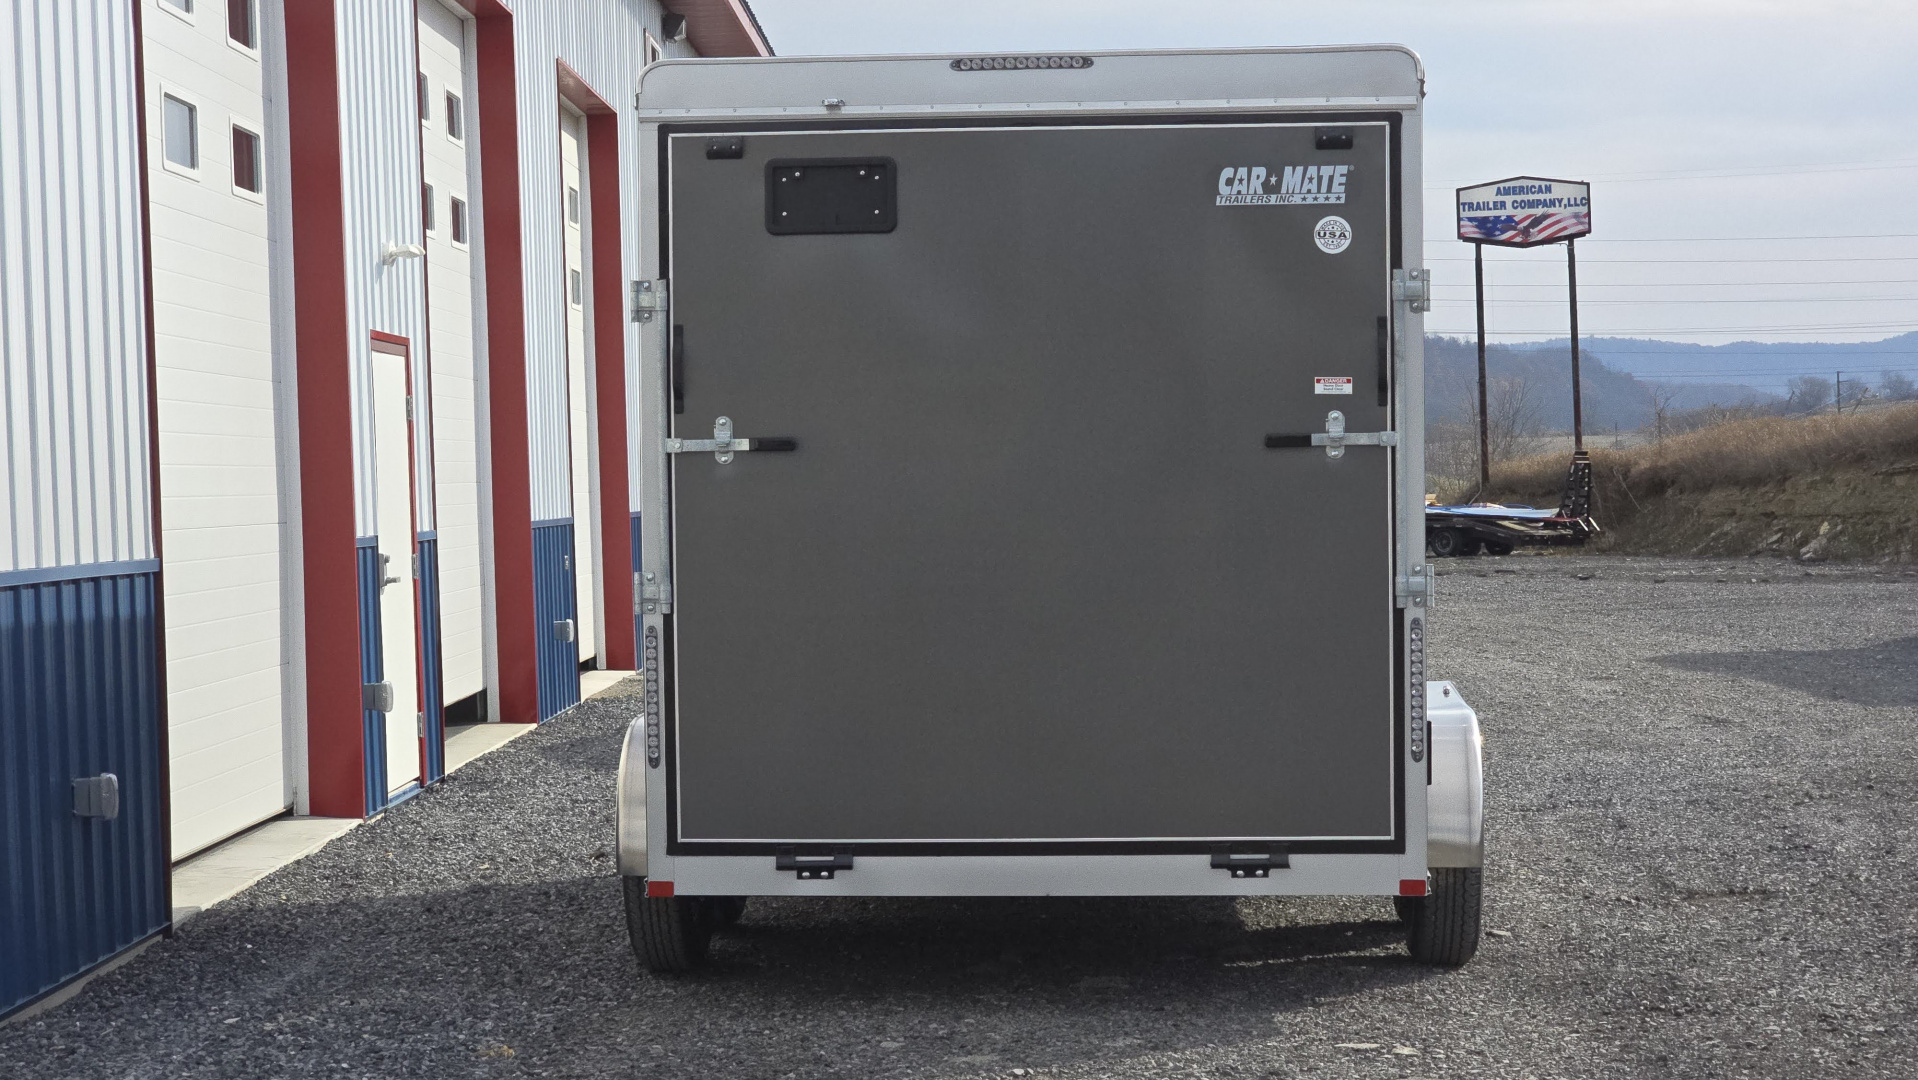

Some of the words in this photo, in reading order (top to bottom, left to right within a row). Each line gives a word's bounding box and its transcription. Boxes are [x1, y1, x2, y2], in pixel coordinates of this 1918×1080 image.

[1218, 166, 1267, 195] CAR
[1280, 165, 1349, 194] MATE
[1495, 184, 1552, 196] AMERICAN
[1219, 195, 1271, 204] TRAILERS
[1274, 195, 1297, 203] INC.
[1461, 200, 1506, 212] TRAILER
[1317, 231, 1347, 239] USA
